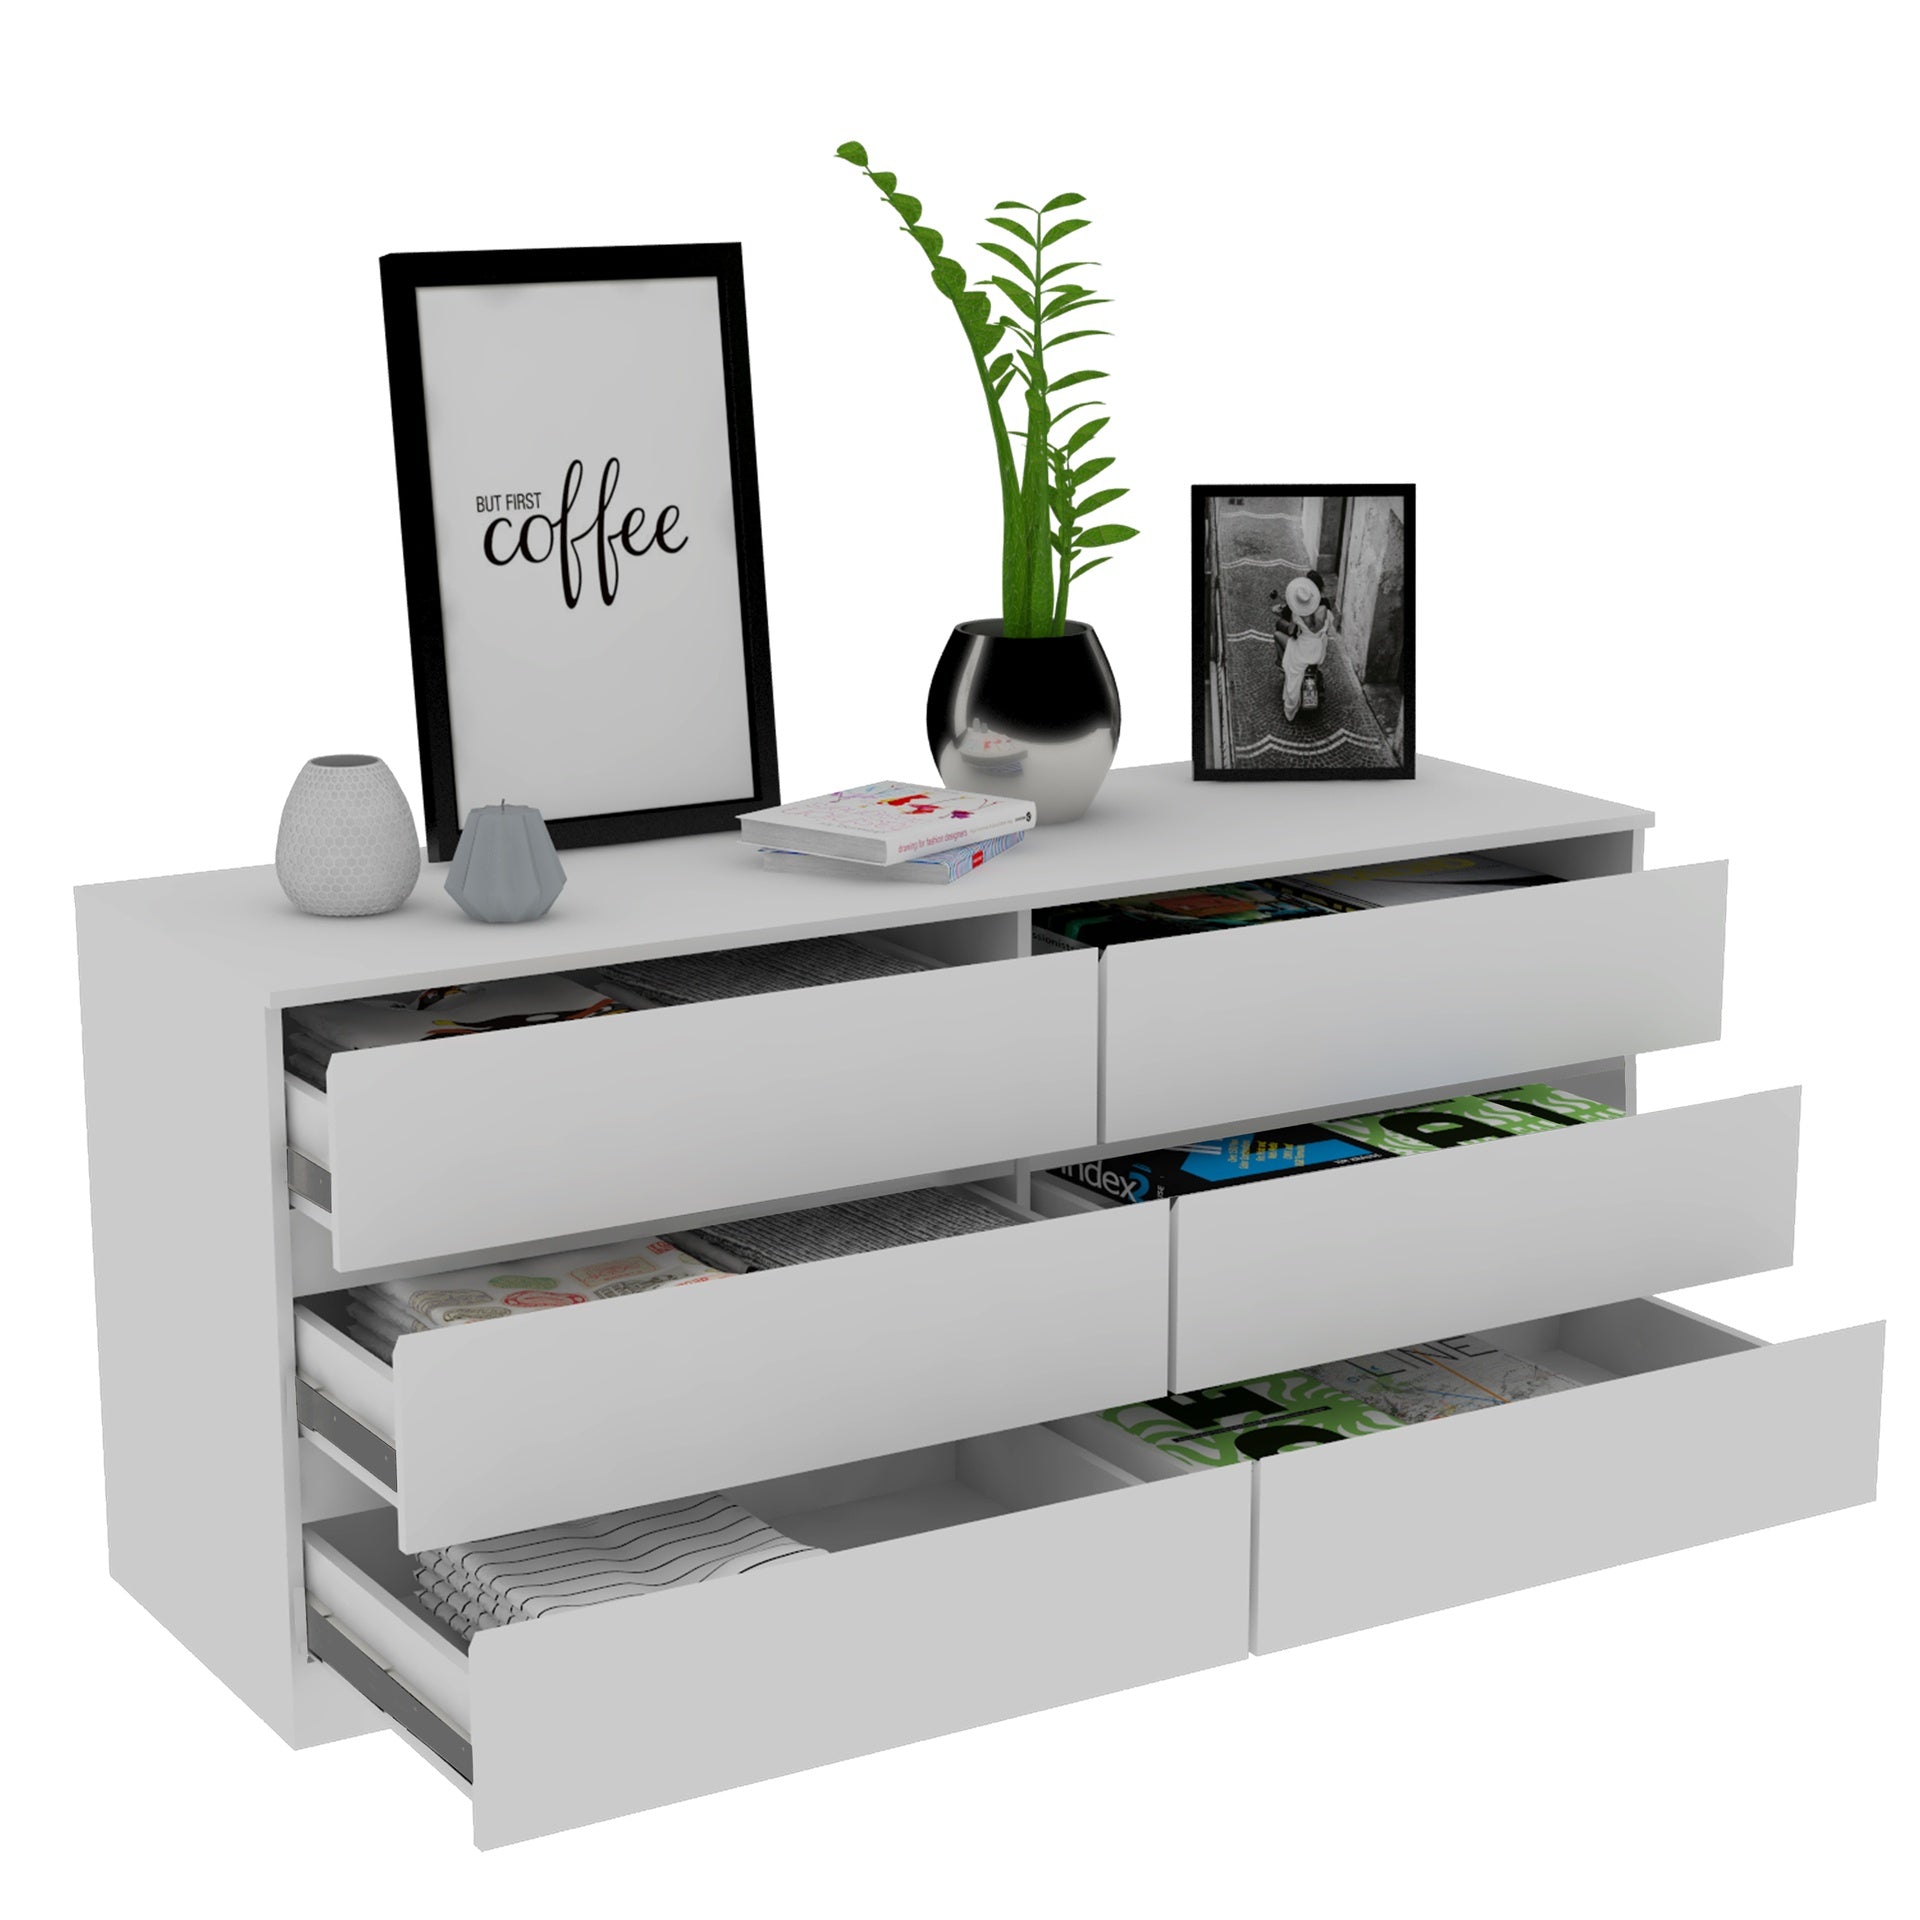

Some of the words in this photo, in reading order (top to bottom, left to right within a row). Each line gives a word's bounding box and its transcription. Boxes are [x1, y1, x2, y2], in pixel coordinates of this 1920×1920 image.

[476, 494, 502, 512] BUT
[506, 492, 542, 510] FIRST
[484, 457, 688, 609] coffee
[944, 829, 968, 842] designers
